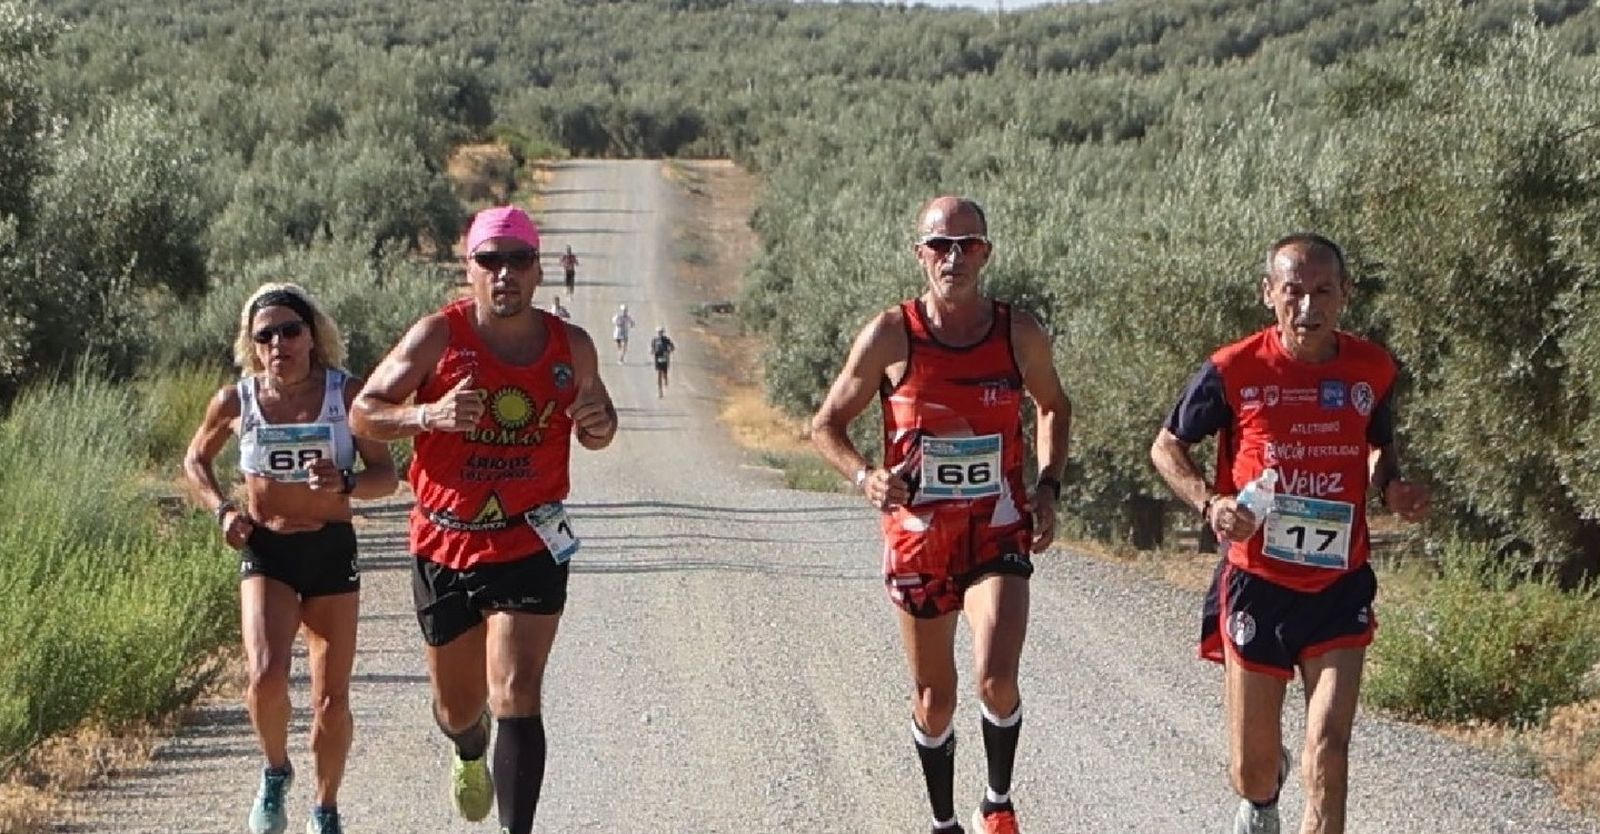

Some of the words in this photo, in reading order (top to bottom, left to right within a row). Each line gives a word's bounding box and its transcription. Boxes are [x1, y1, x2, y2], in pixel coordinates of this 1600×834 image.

[937, 462, 991, 485] 66
[1279, 465, 1345, 496] Vélez
[1286, 525, 1338, 552] 17
